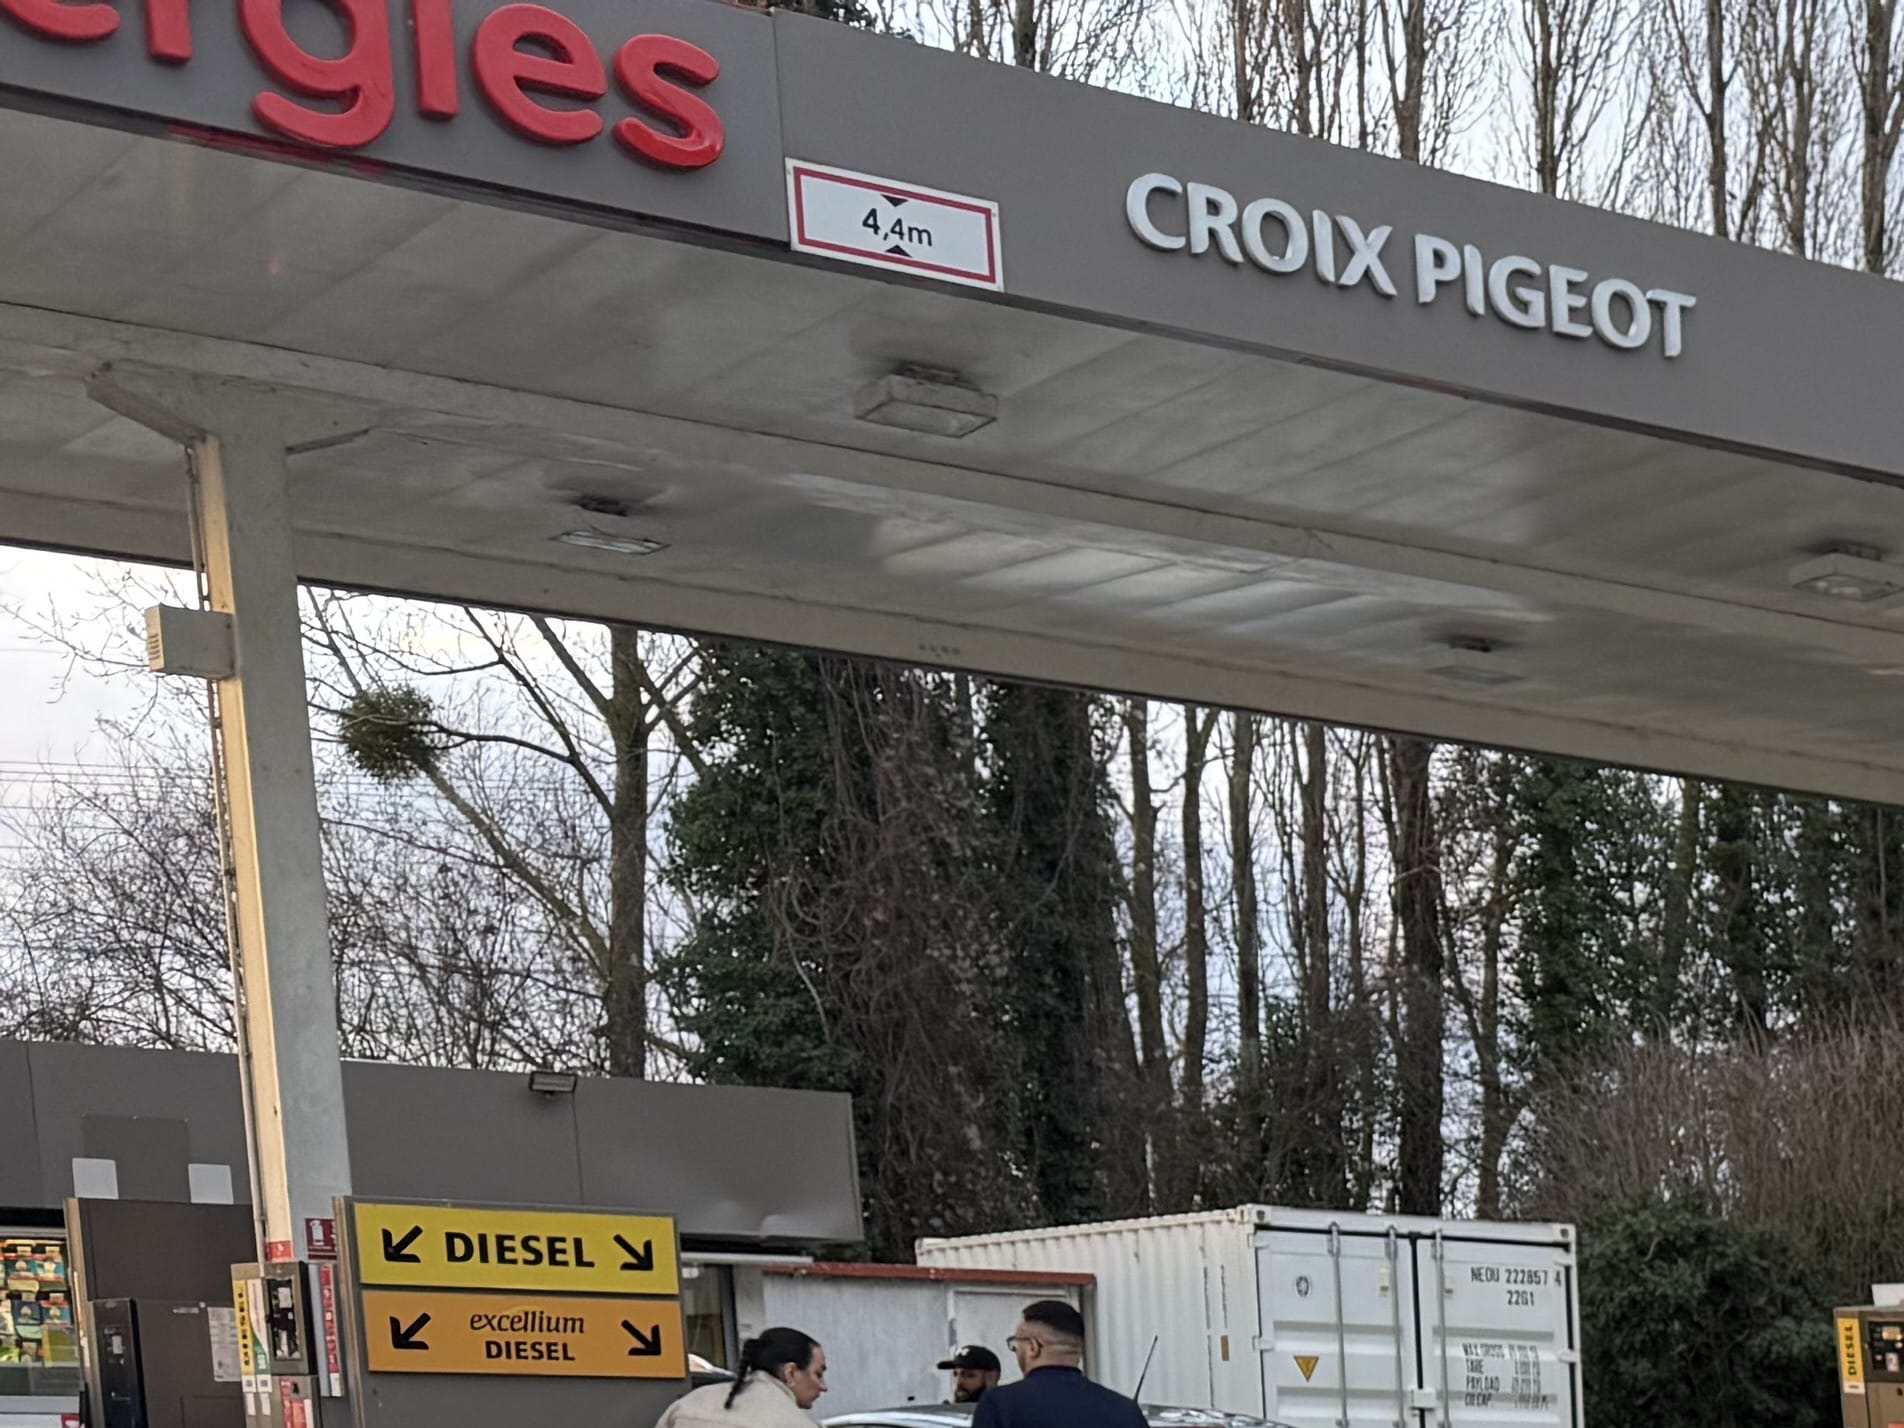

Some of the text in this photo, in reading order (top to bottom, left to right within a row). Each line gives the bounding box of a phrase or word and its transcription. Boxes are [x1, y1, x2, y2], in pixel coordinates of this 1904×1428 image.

[862, 207, 933, 247] 4,4m
[1126, 172, 1697, 358] CROIX PIGEOT
[445, 1231, 595, 1268] DIESEL
[469, 1310, 584, 1333] excellium
[485, 1341, 575, 1360] DIESEL
[1844, 1324, 1857, 1376] DIESEL
